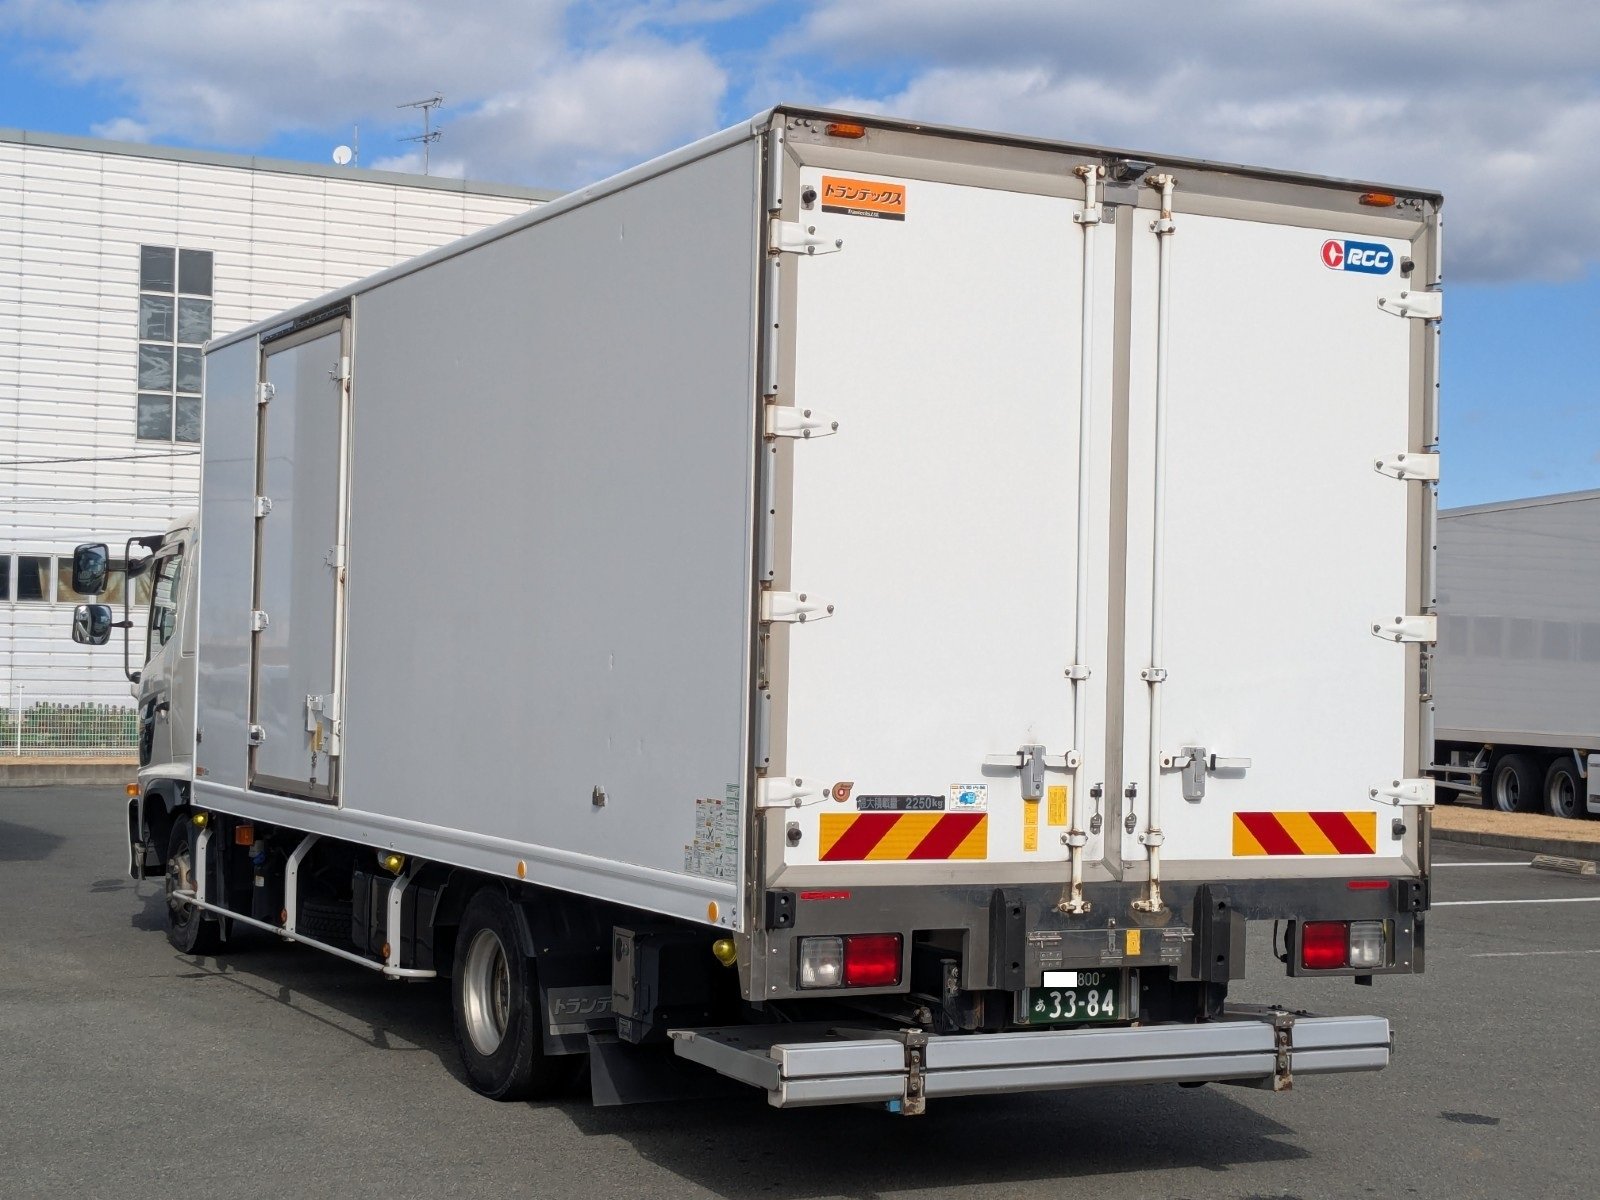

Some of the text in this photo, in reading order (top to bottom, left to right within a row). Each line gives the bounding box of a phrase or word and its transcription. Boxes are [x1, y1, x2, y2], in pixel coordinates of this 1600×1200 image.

[825, 184, 902, 205] トランテックス
[1346, 247, 1390, 268] RCC
[905, 797, 944, 809] 2250kg
[1078, 972, 1100, 987] 800
[1034, 989, 1114, 1019] あ 33-84
